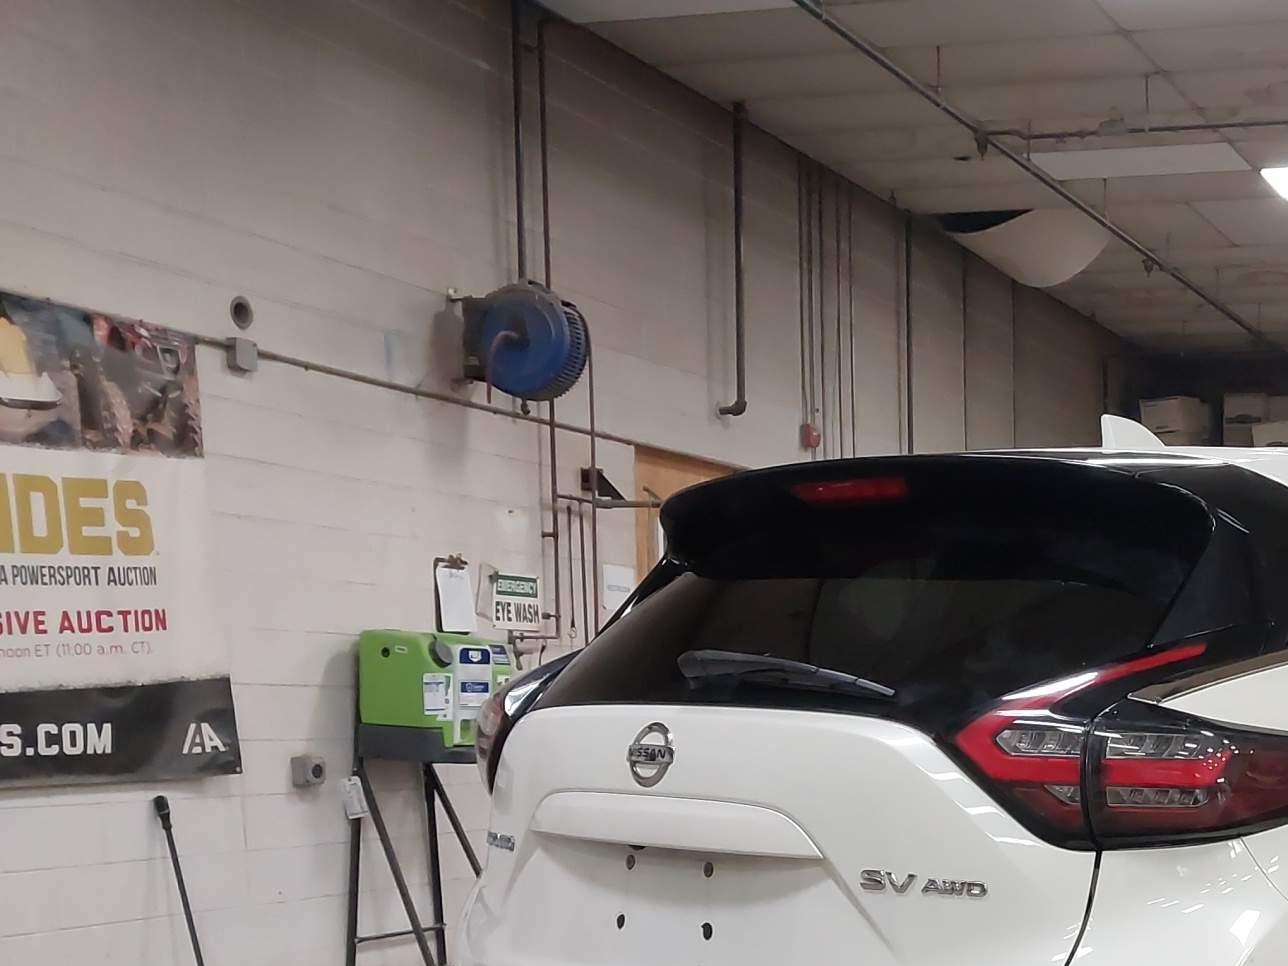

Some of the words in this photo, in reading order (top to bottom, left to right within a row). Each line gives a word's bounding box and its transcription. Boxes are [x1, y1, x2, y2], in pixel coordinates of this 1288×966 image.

[11, 565, 100, 586] POWERSPORT
[107, 566, 157, 586] AUCTION
[59, 608, 168, 634] AUCTION
[495, 600, 512, 622] EYE
[513, 602, 540, 624] WASH
[35, 643, 51, 657] ET
[0, 722, 112, 756] S.COM
[629, 746, 667, 760] SSAN
[860, 869, 917, 894] SV
[921, 878, 987, 898] AWD
